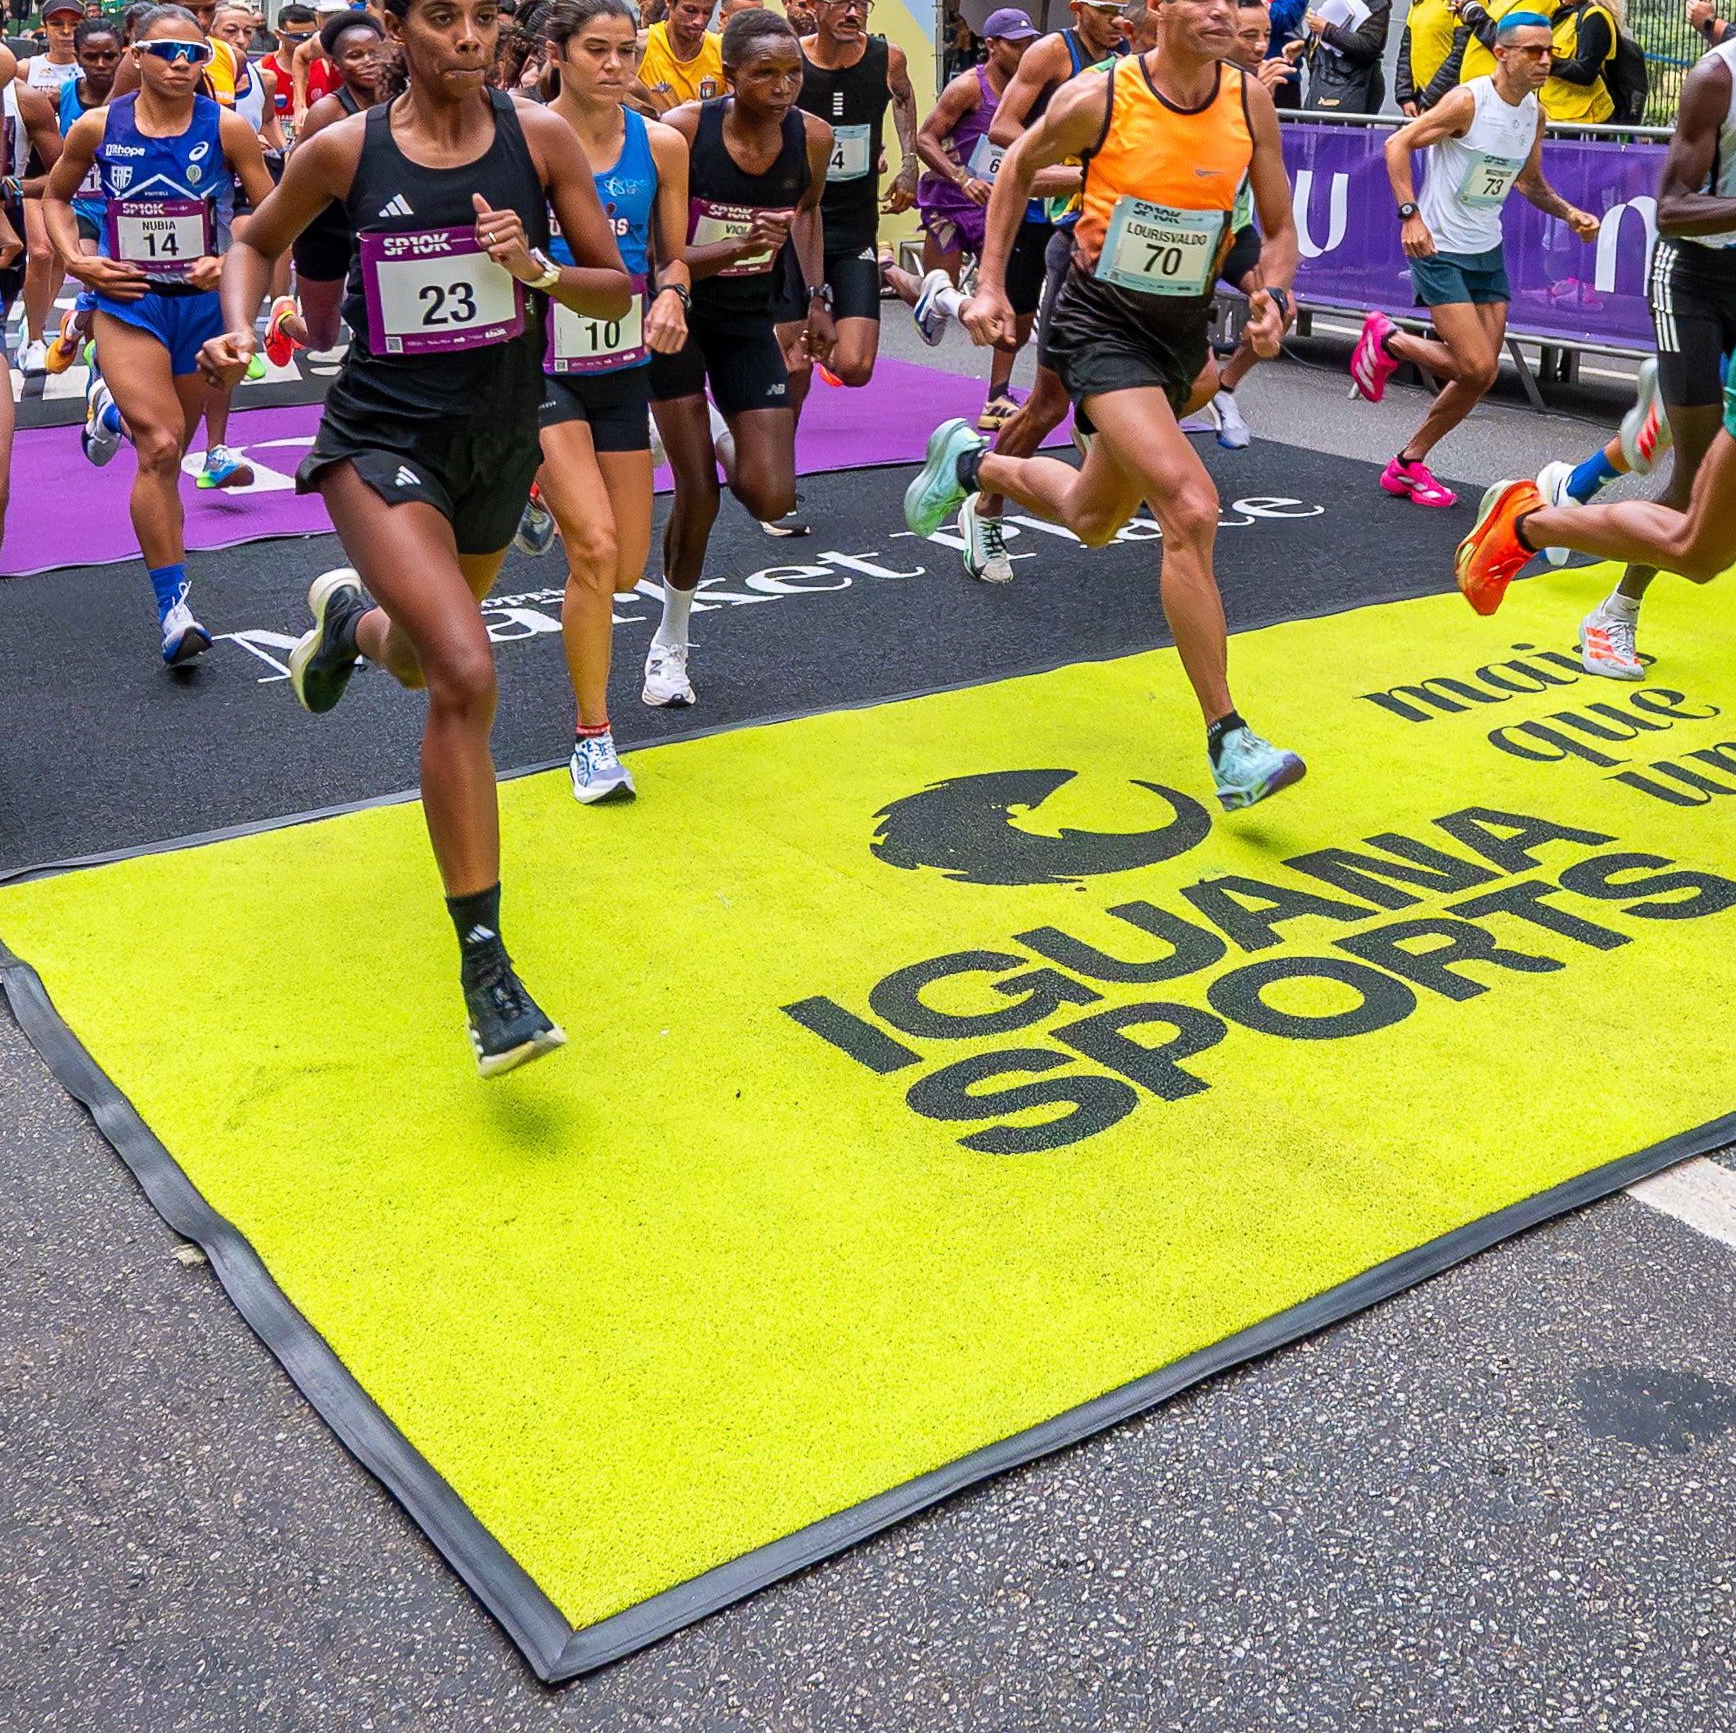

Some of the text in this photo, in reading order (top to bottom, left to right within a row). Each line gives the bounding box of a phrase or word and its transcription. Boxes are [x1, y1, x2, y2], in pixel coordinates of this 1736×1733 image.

[1483, 177, 1505, 196] 73
[122, 203, 165, 215] SP10K
[142, 221, 176, 230] NUBIA
[1127, 222, 1208, 246] LOURISVALDO
[143, 232, 179, 257] 14
[383, 233, 452, 256] SP10K
[1143, 243, 1183, 276] 70
[419, 282, 477, 326] 23
[585, 321, 621, 351] 10
[1354, 642, 1657, 722] mai
[1486, 686, 1722, 768] que
[780, 805, 1620, 1076] IGUANA
